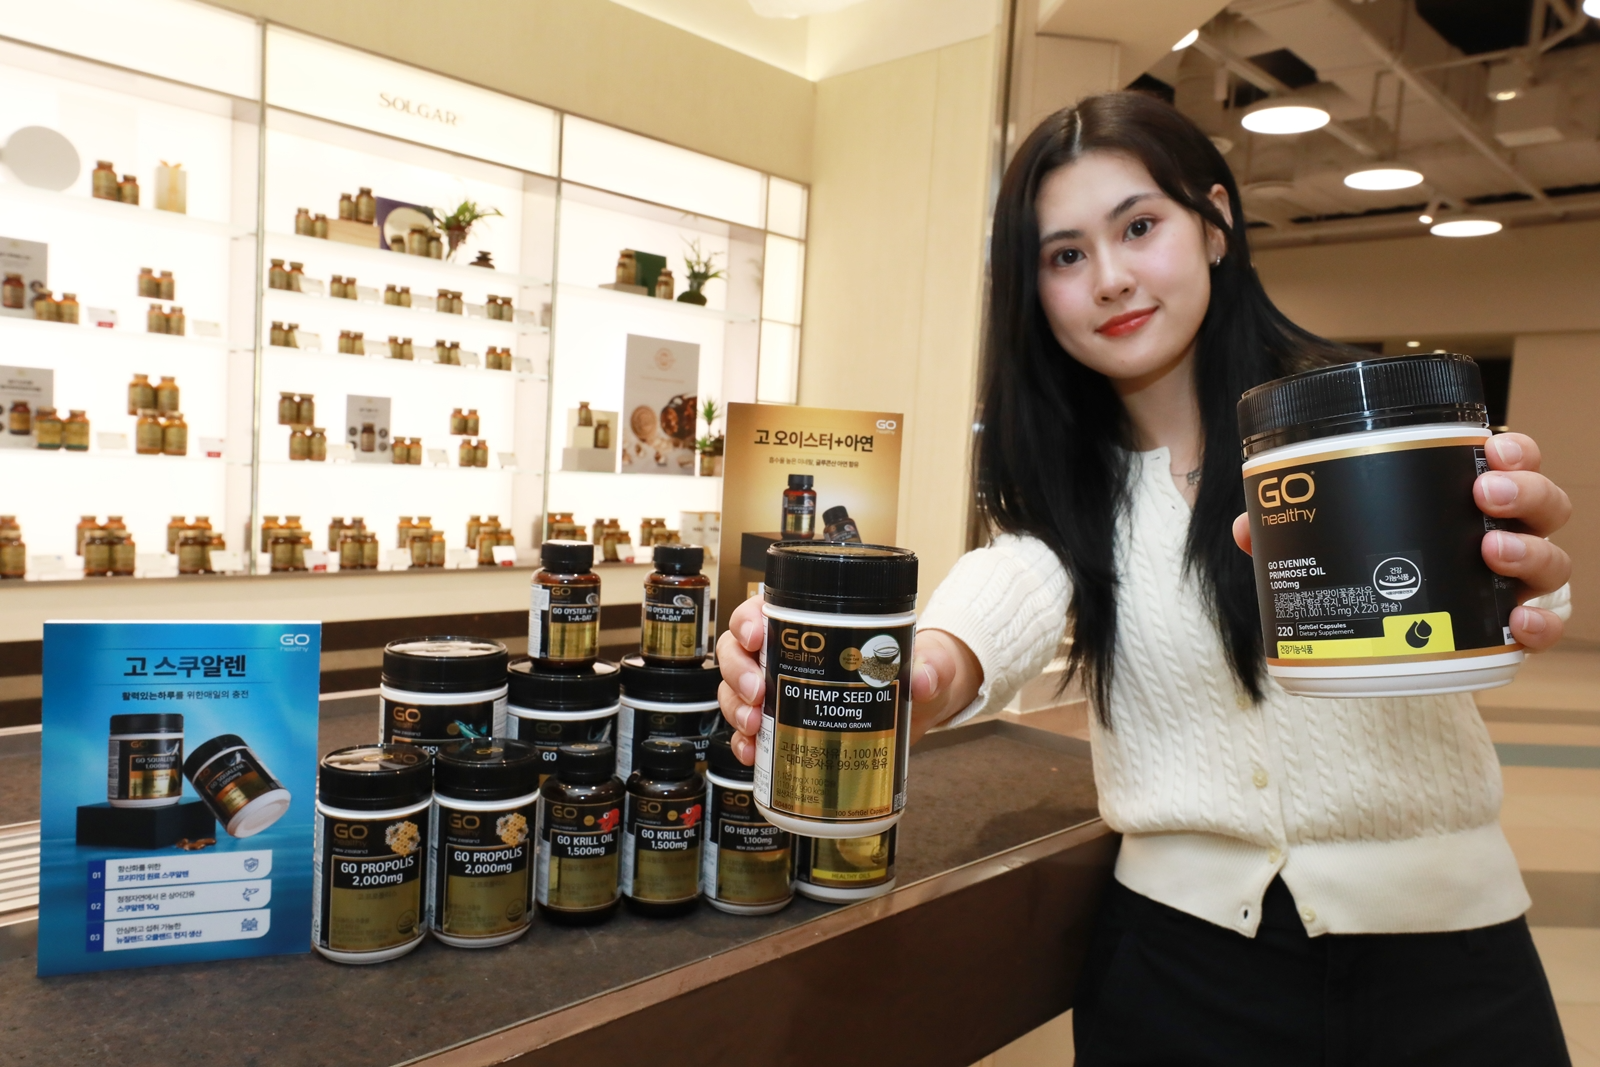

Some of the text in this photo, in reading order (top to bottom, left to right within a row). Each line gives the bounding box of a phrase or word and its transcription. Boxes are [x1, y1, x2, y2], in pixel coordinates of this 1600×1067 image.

[379, 92, 457, 126] SOLGAR
[876, 420, 896, 430] GO
[754, 430, 874, 452] 고 오이스터+아연
[1258, 472, 1315, 508] GO
[1261, 508, 1316, 526] healthy
[1268, 558, 1316, 570] GO EVENING
[1269, 567, 1326, 580] PRIMROSE OIL
[552, 587, 571, 596] GO
[1338, 608, 1351, 616] mg
[1353, 605, 1360, 614] X
[1362, 603, 1379, 613] 220
[1380, 601, 1402, 613] 캡슐)
[656, 614, 682, 622] 1-A-DAY
[1277, 626, 1294, 637] 220
[1318, 628, 1354, 636] Supplement
[280, 634, 310, 646] GO
[781, 628, 826, 653] GO
[1280, 644, 1313, 654] 건강기능식품
[780, 649, 824, 666] healthy
[124, 655, 246, 678] 고 스쿠알렌
[779, 663, 825, 675] new zealand
[122, 690, 184, 700] 활력있는하루를
[232, 690, 249, 699] 충전
[785, 685, 892, 703] GO HEMP SEED OIL
[393, 706, 421, 722] GO
[814, 704, 863, 720] 1,100mg
[542, 752, 557, 761] GO
[781, 742, 788, 751] 고
[790, 744, 840, 758] 대마종자유
[844, 749, 871, 760] 1,100
[874, 747, 888, 757] MG
[786, 754, 887, 770] 대마종자유 99.9% 함유
[722, 791, 750, 807] GO
[552, 805, 577, 819] GO
[637, 801, 661, 813] GO
[449, 813, 480, 829] GO
[334, 823, 368, 839] GO
[642, 828, 696, 840] GO KRILL OIL
[724, 825, 735, 834] GO
[736, 827, 758, 835] HEMP
[761, 827, 778, 835] SEED
[557, 834, 614, 846] GO KRILL OIL
[651, 840, 688, 850] 1,500mg
[743, 837, 772, 845] 1,100mg
[454, 847, 522, 862] GO PROPOLIS
[567, 846, 605, 856] 1,500mg
[147, 863, 161, 871] 위한
[341, 856, 414, 874] GO PROPOLIS
[465, 863, 512, 874] 2,000mg
[162, 871, 189, 879] 스쿠알렌
[352, 873, 403, 887] 2,000mg
[146, 903, 159, 911] 10g
[161, 923, 181, 931] 가능한
